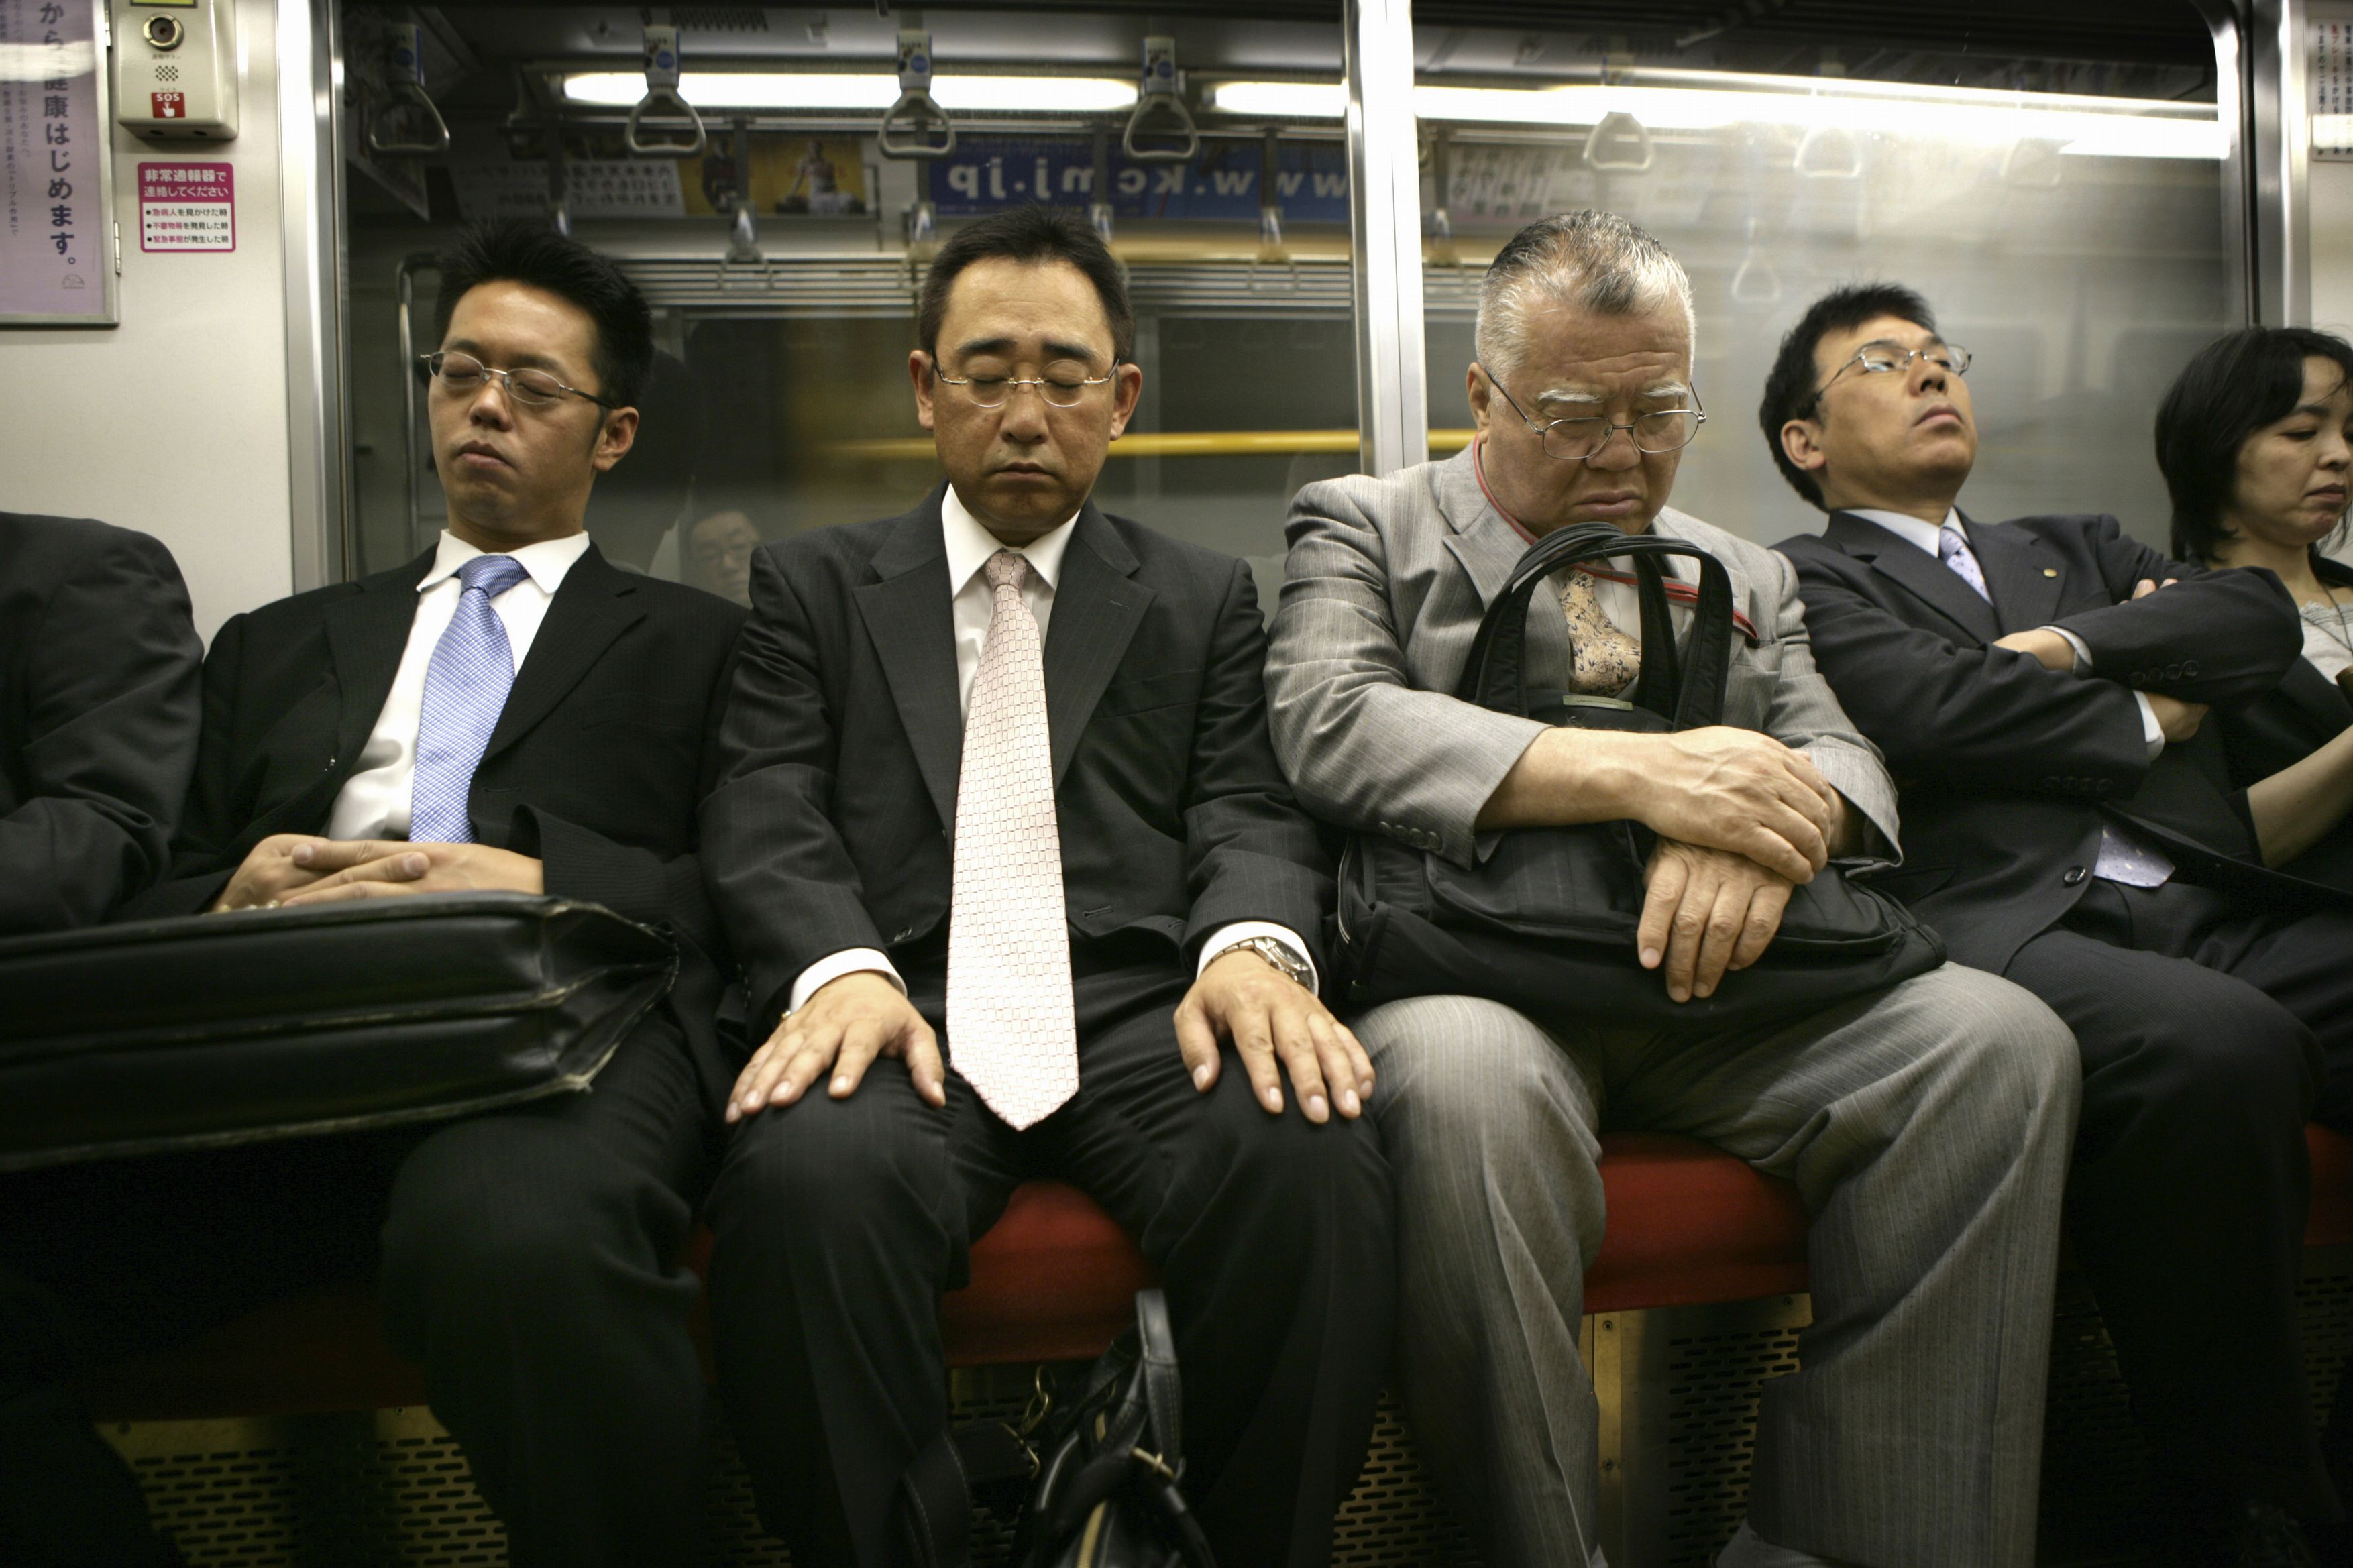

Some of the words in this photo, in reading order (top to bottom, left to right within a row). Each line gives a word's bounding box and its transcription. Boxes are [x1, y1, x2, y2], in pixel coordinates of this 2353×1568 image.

[156, 93, 180, 101] SOS
[145, 169, 227, 182] 非常通報器で
[144, 186, 229, 197] 連絡してください
